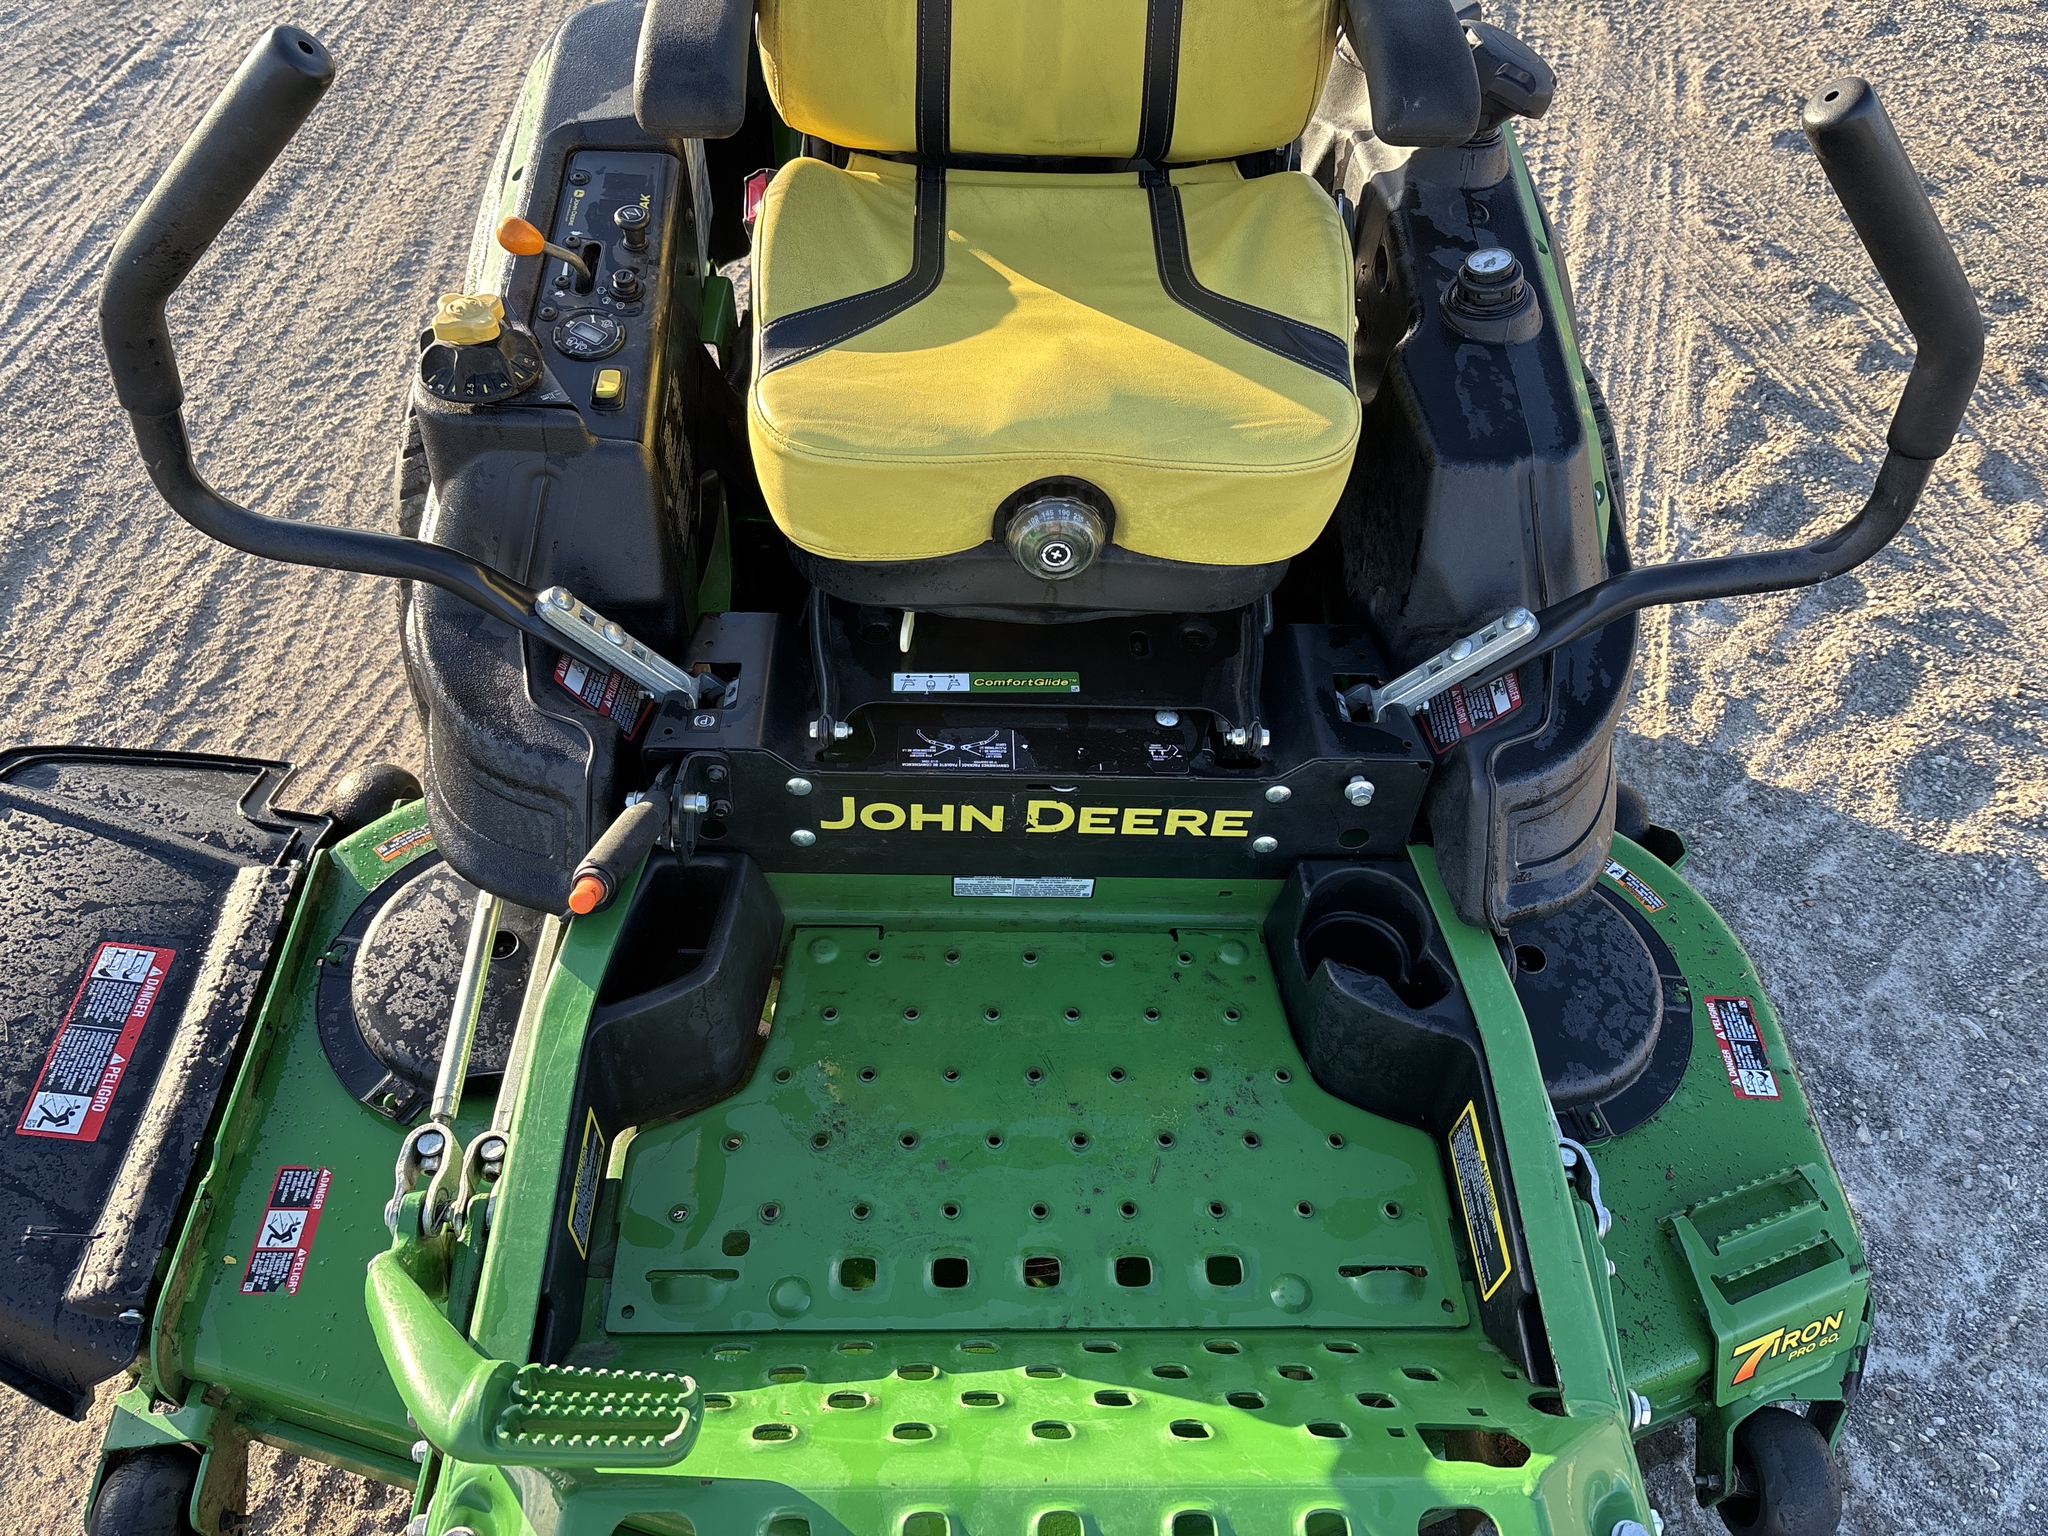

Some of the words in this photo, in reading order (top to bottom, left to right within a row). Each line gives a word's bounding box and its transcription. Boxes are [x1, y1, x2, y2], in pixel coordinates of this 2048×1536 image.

[572, 197, 581, 210] JOHN
[568, 210, 577, 226] DEERE
[467, 384, 475, 395] 2.5
[1041, 510, 1054, 518] 145
[606, 674, 621, 702] PELIGRO
[1504, 673, 1520, 701] DANGER
[1453, 695, 1468, 724] PELIGRO
[820, 796, 1004, 832] JOHN
[1025, 800, 1253, 837] DEERE
[132, 979, 160, 1018] DANGER
[1706, 1003, 1722, 1030] PELIGRO
[1722, 1049, 1738, 1077] DANGER
[92, 1065, 129, 1112] PELIGRO
[312, 1177, 331, 1210] DANGER
[1787, 1343, 1816, 1362] PRO
